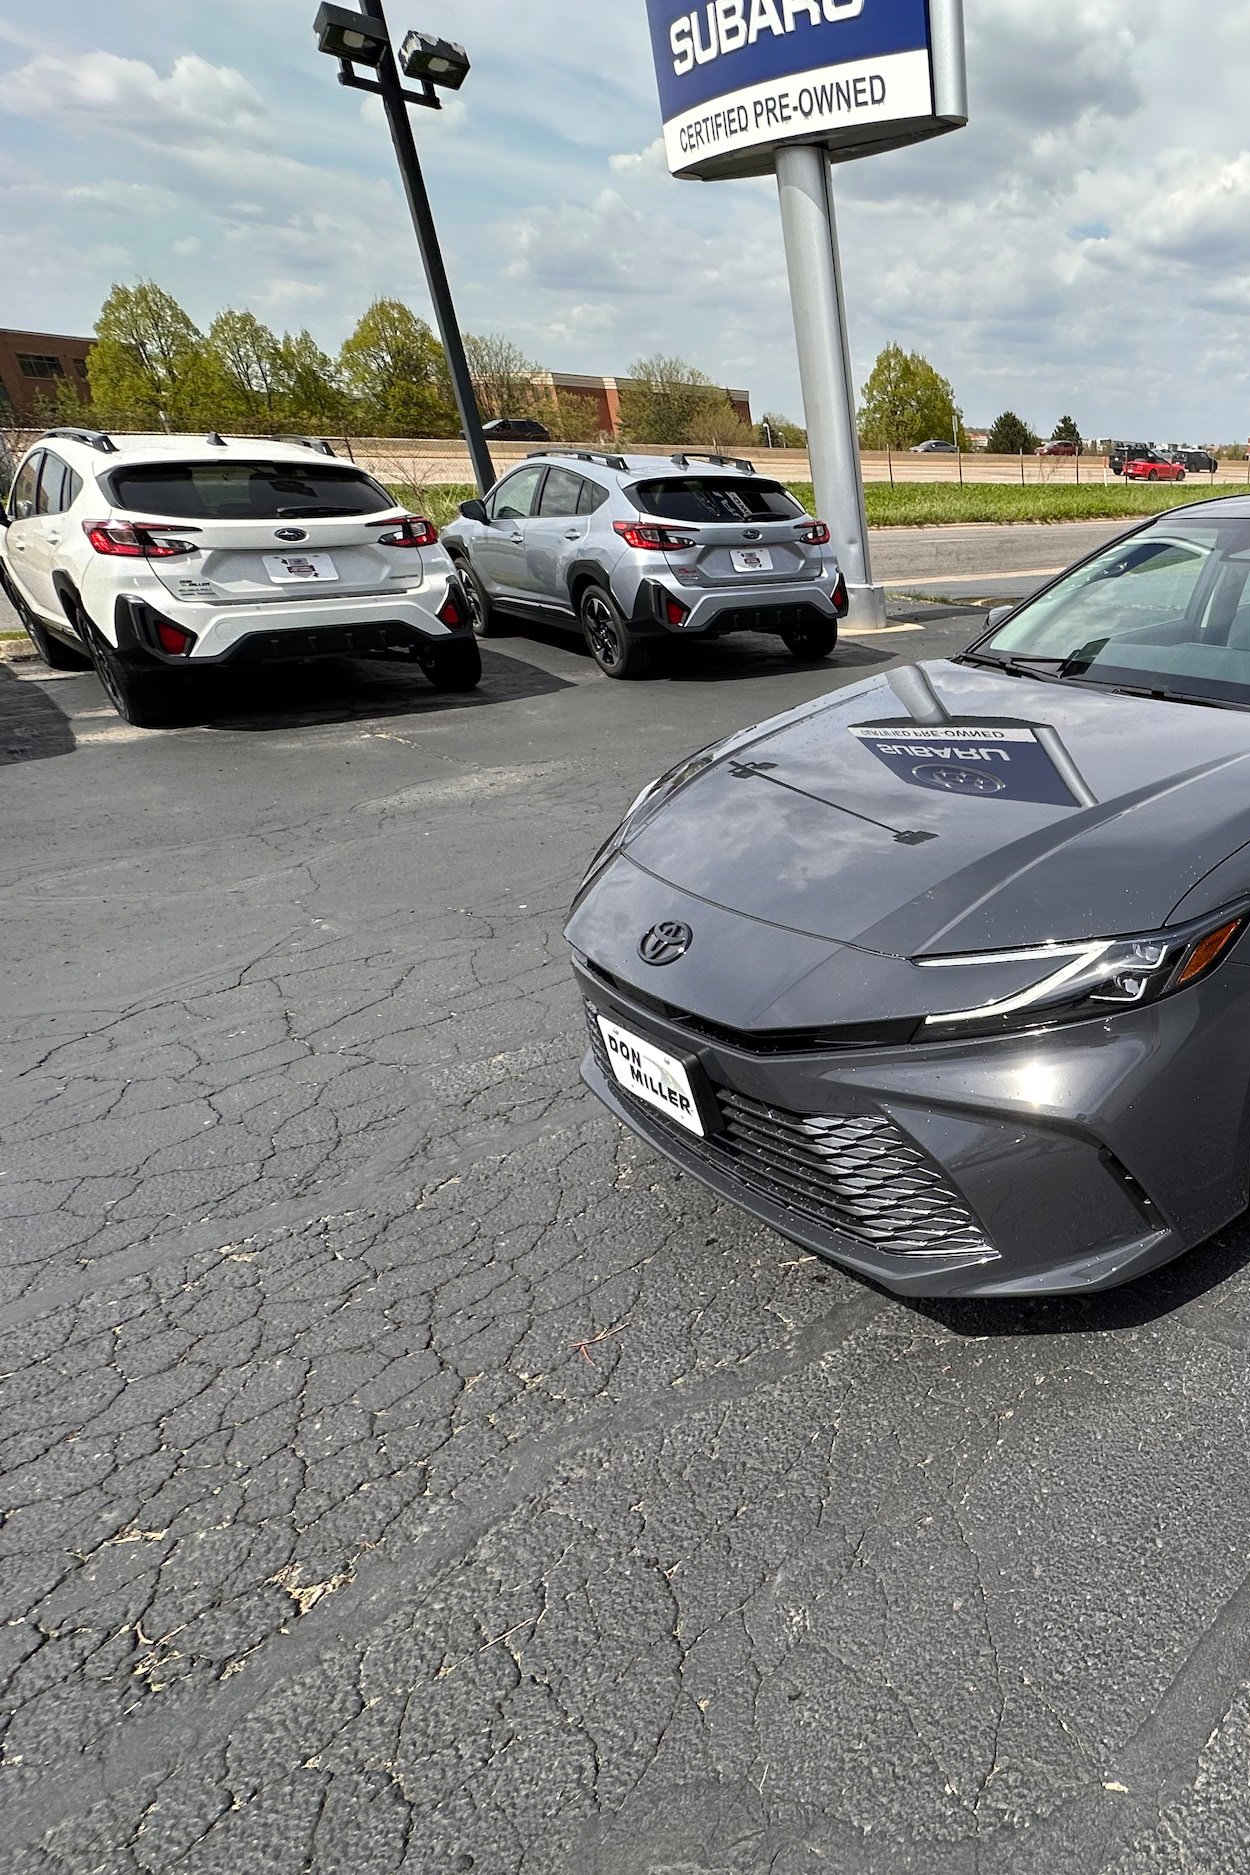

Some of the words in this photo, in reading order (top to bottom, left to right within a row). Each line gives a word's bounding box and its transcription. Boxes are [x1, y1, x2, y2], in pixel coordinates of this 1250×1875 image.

[679, 104, 749, 153] CERTIFIED
[752, 74, 887, 129] PRE-OWNED
[608, 1033, 641, 1069] DON
[630, 1063, 693, 1117] MILLER
